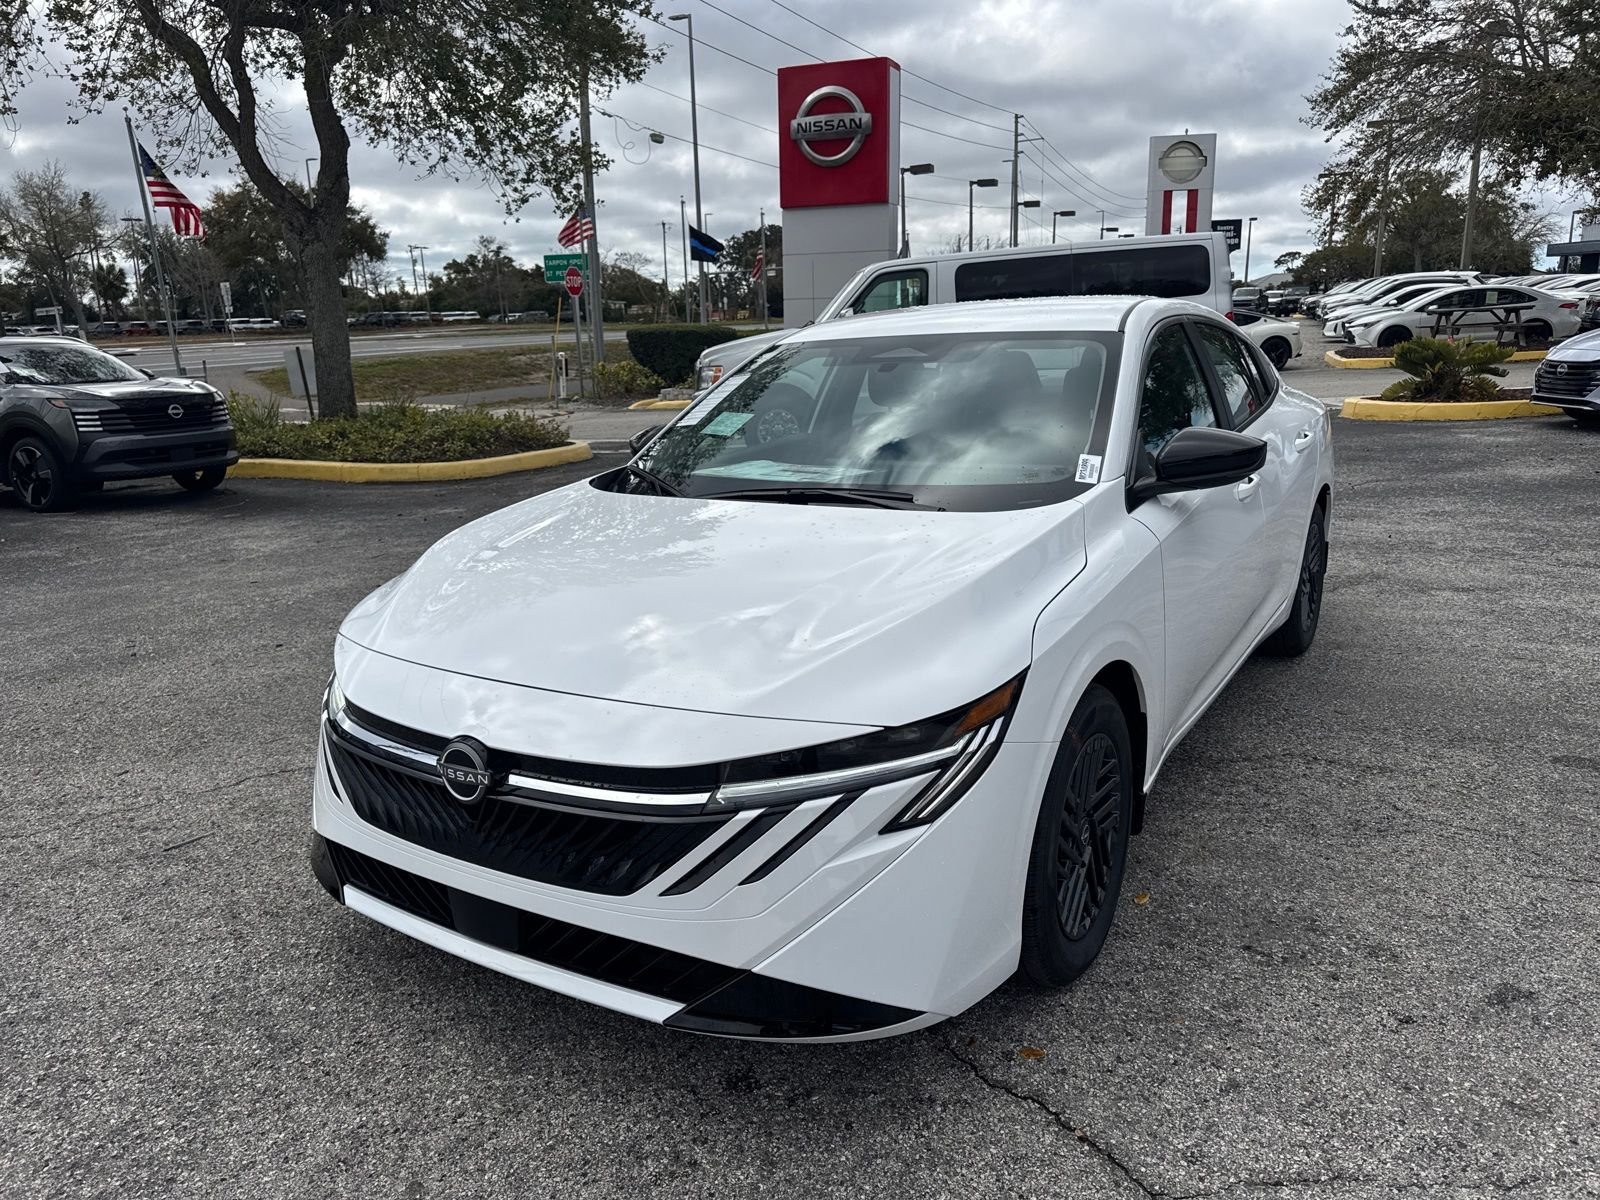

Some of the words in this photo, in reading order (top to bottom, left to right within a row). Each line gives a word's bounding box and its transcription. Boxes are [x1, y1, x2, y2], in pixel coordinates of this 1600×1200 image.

[796, 117, 863, 134] NISSAN
[566, 276, 582, 287] STOP
[437, 764, 488, 784] NISSAN
